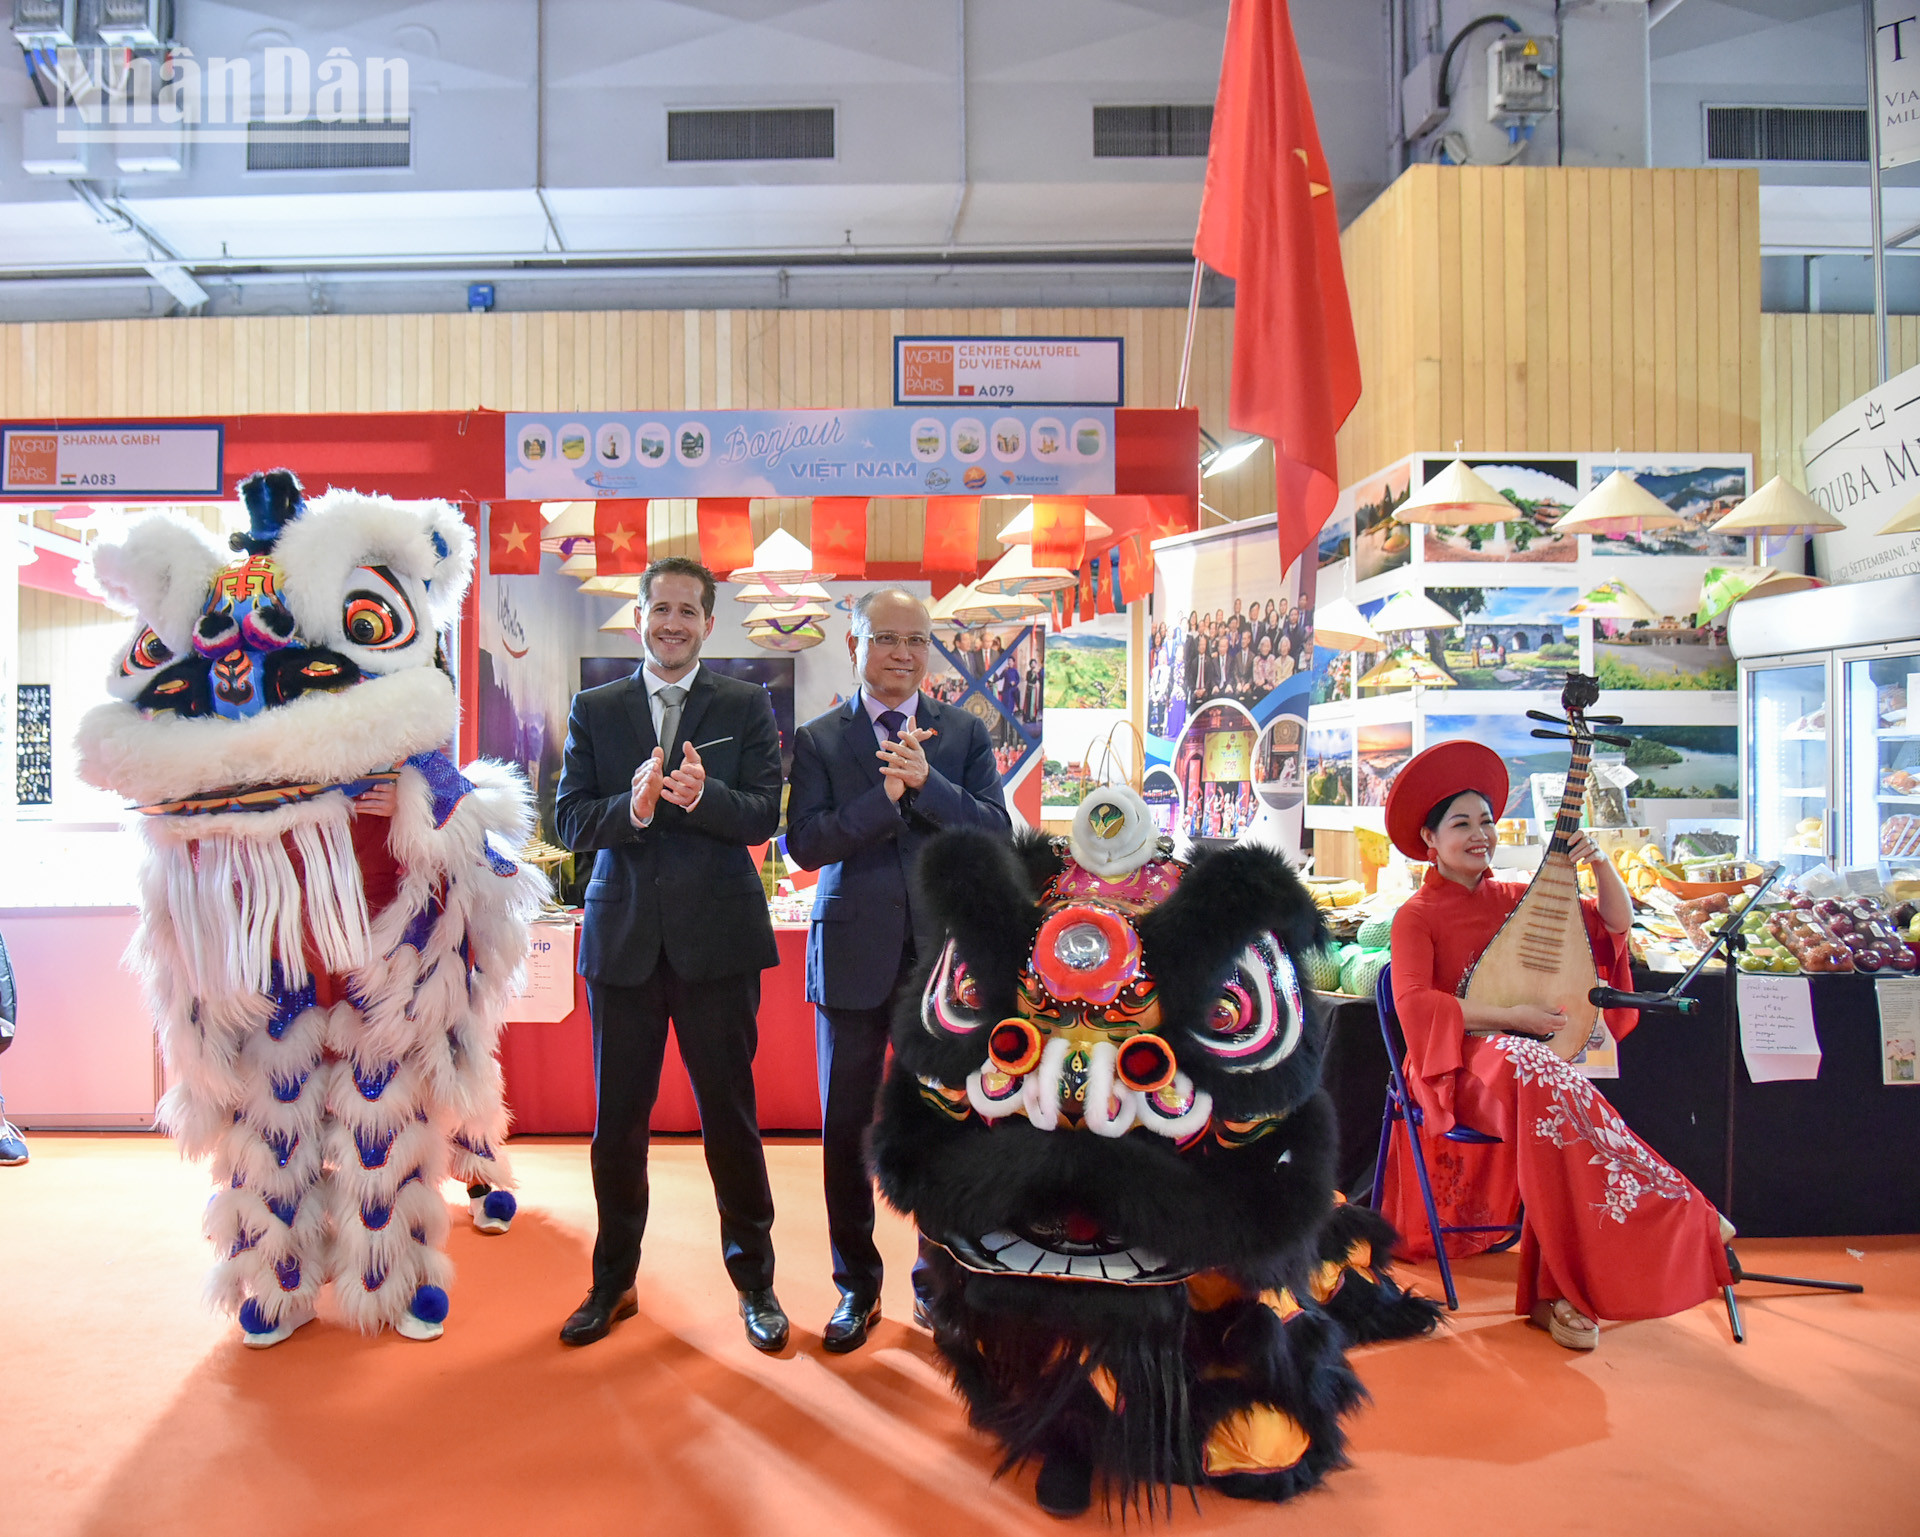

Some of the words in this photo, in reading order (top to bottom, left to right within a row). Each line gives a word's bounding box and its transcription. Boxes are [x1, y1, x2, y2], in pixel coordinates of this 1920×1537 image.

[905, 349, 952, 364] WORLD
[958, 346, 1011, 357] CENTRE
[1014, 346, 1081, 357] CULTUREL
[958, 358, 979, 369] DU
[982, 358, 1042, 369] VIETNAM
[906, 365, 922, 378] IN
[905, 378, 944, 392] PARIS
[978, 385, 1014, 397] A079
[11, 439, 57, 454] WORLD
[62, 435, 118, 445] SHARMA
[121, 435, 161, 445] GMBH
[719, 416, 845, 469] Bonjour
[10, 454, 27, 467] IN
[1883, 438, 1920, 487] M
[10, 467, 48, 481] PARIS
[789, 458, 847, 482] VIỆT
[855, 462, 917, 478] NAM
[80, 474, 116, 485] A083
[1016, 474, 1059, 483] Vietravel
